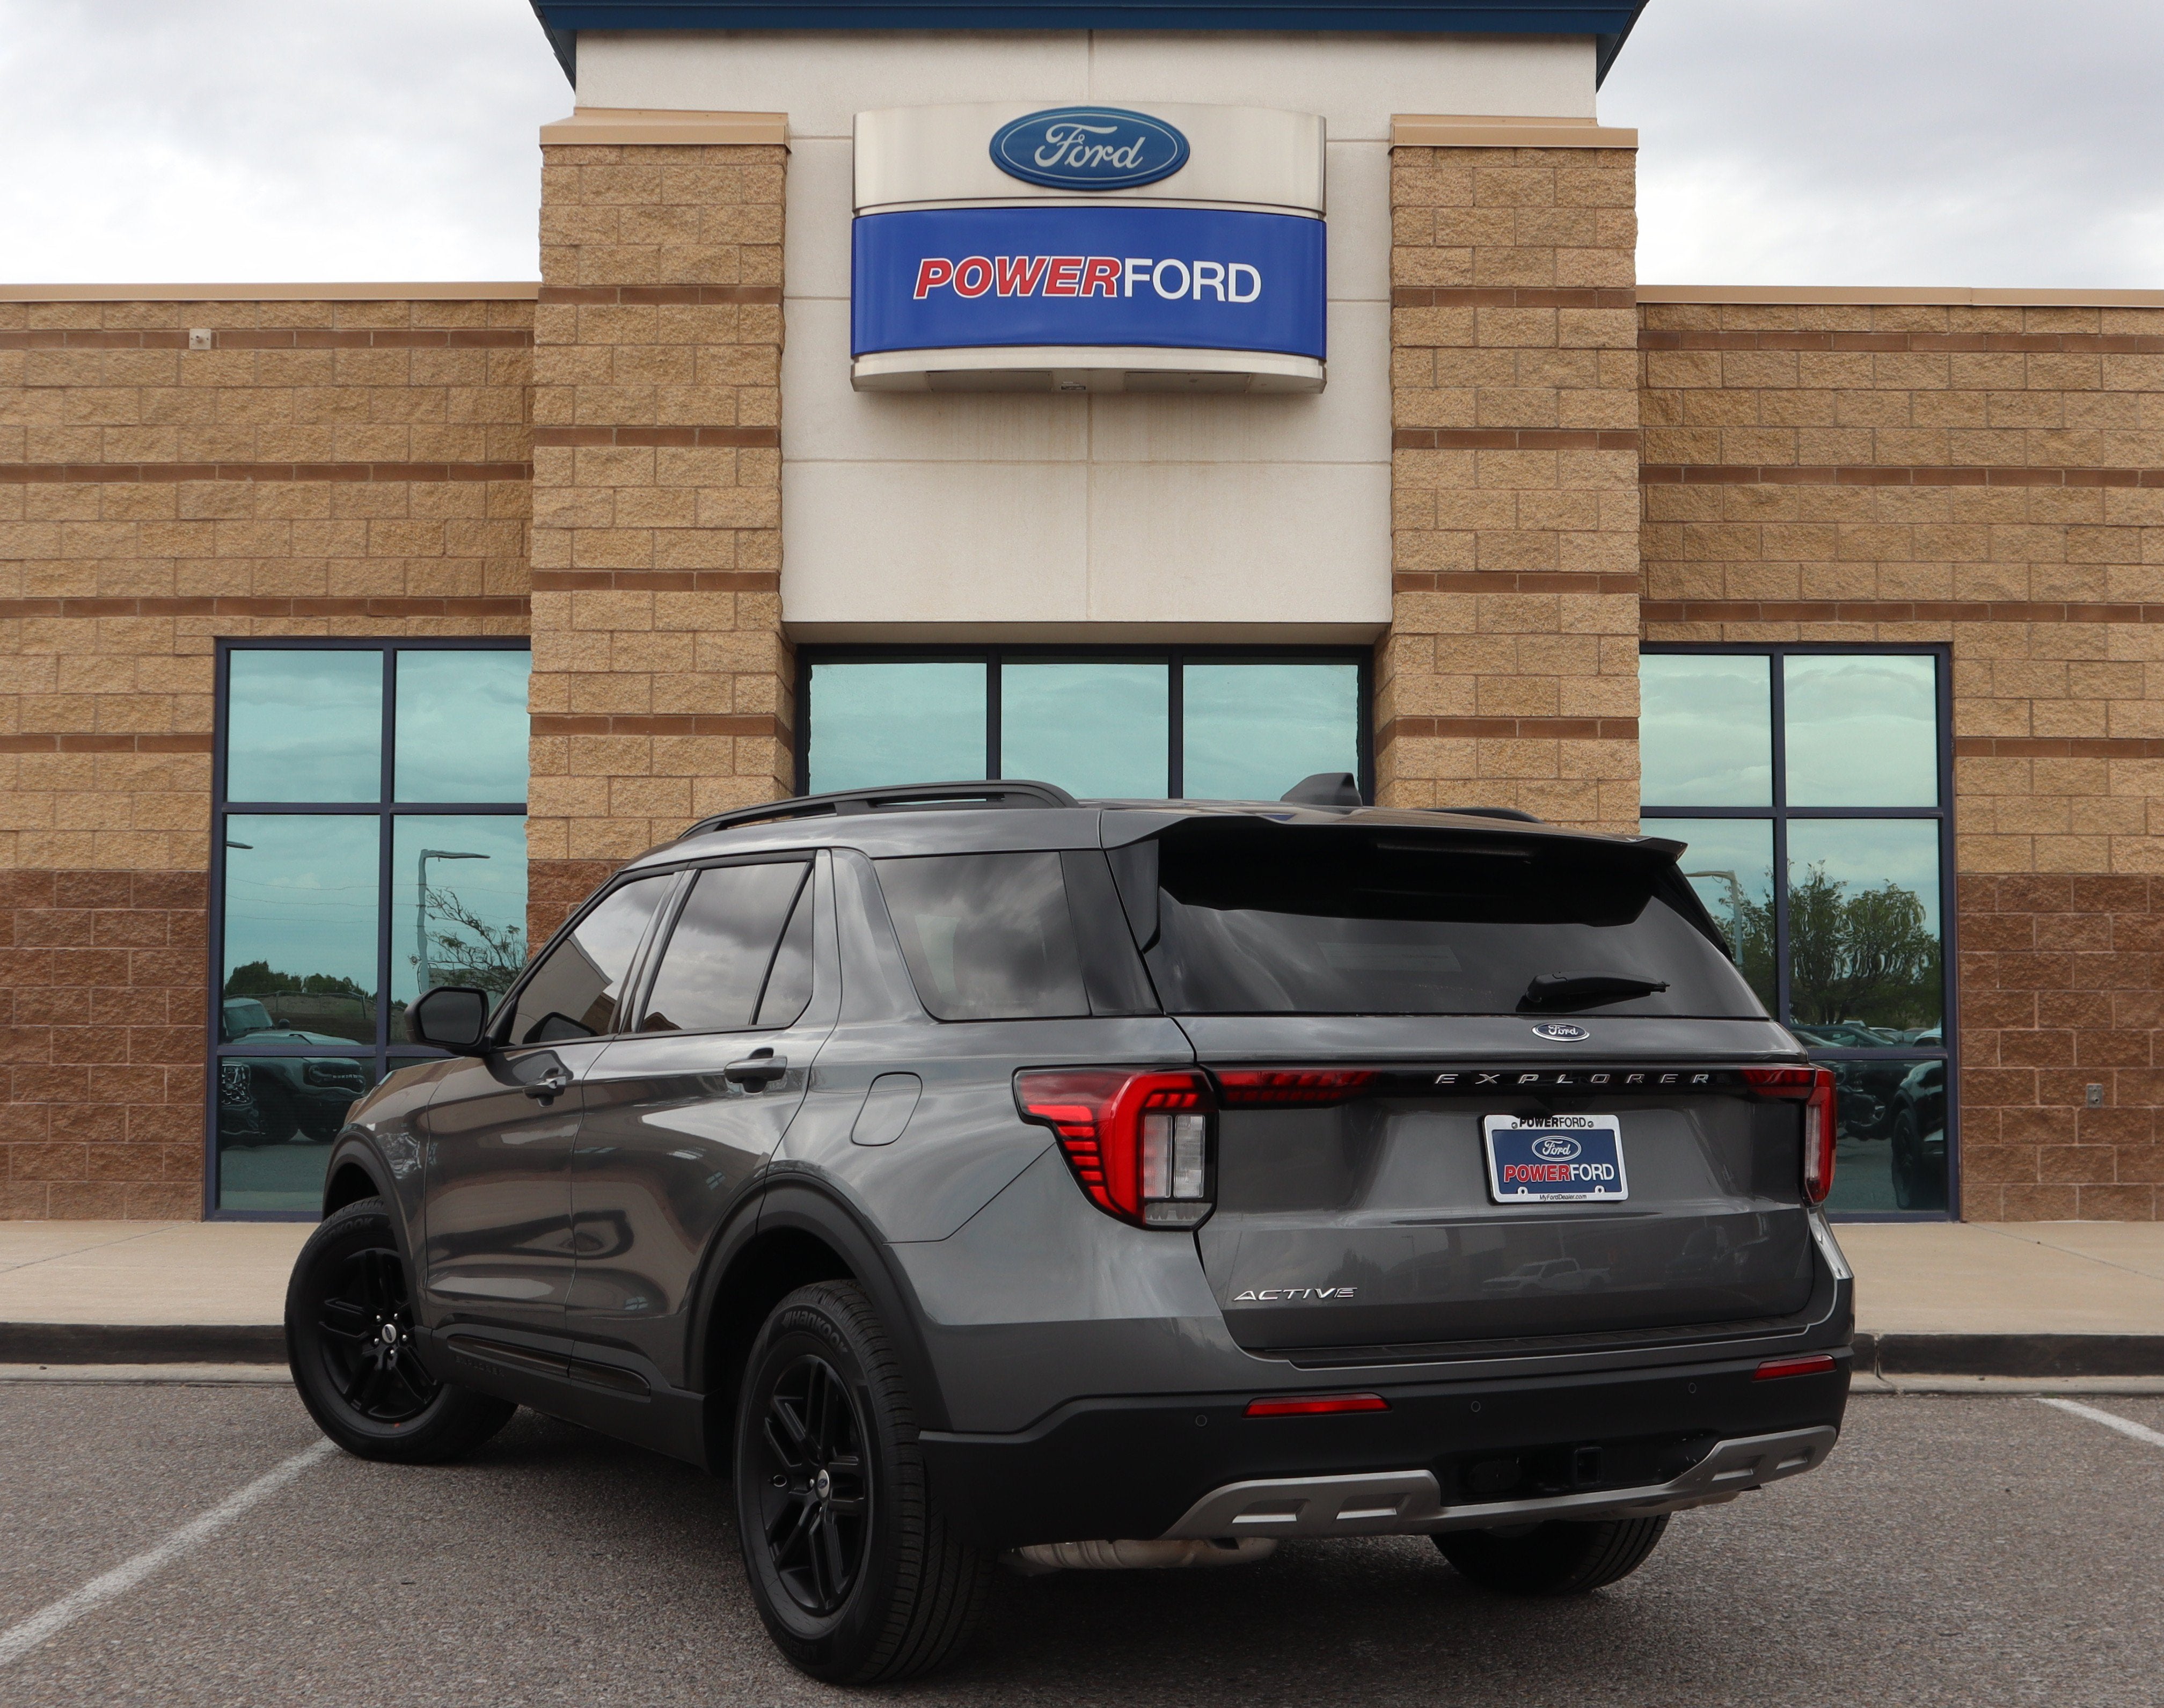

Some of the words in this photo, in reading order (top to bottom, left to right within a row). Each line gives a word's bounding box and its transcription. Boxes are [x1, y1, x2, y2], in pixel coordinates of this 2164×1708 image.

[1034, 123, 1144, 169] Ford
[913, 256, 1262, 303] POWERFORD
[1548, 1024, 1578, 1036] Ford
[1434, 1074, 1709, 1084] EXPLORER
[1519, 1116, 1587, 1128] POWERFORD
[1542, 1140, 1571, 1156] Ford
[1503, 1163, 1614, 1183] POWERFORD
[1233, 1287, 1358, 1301] ACTIVE
